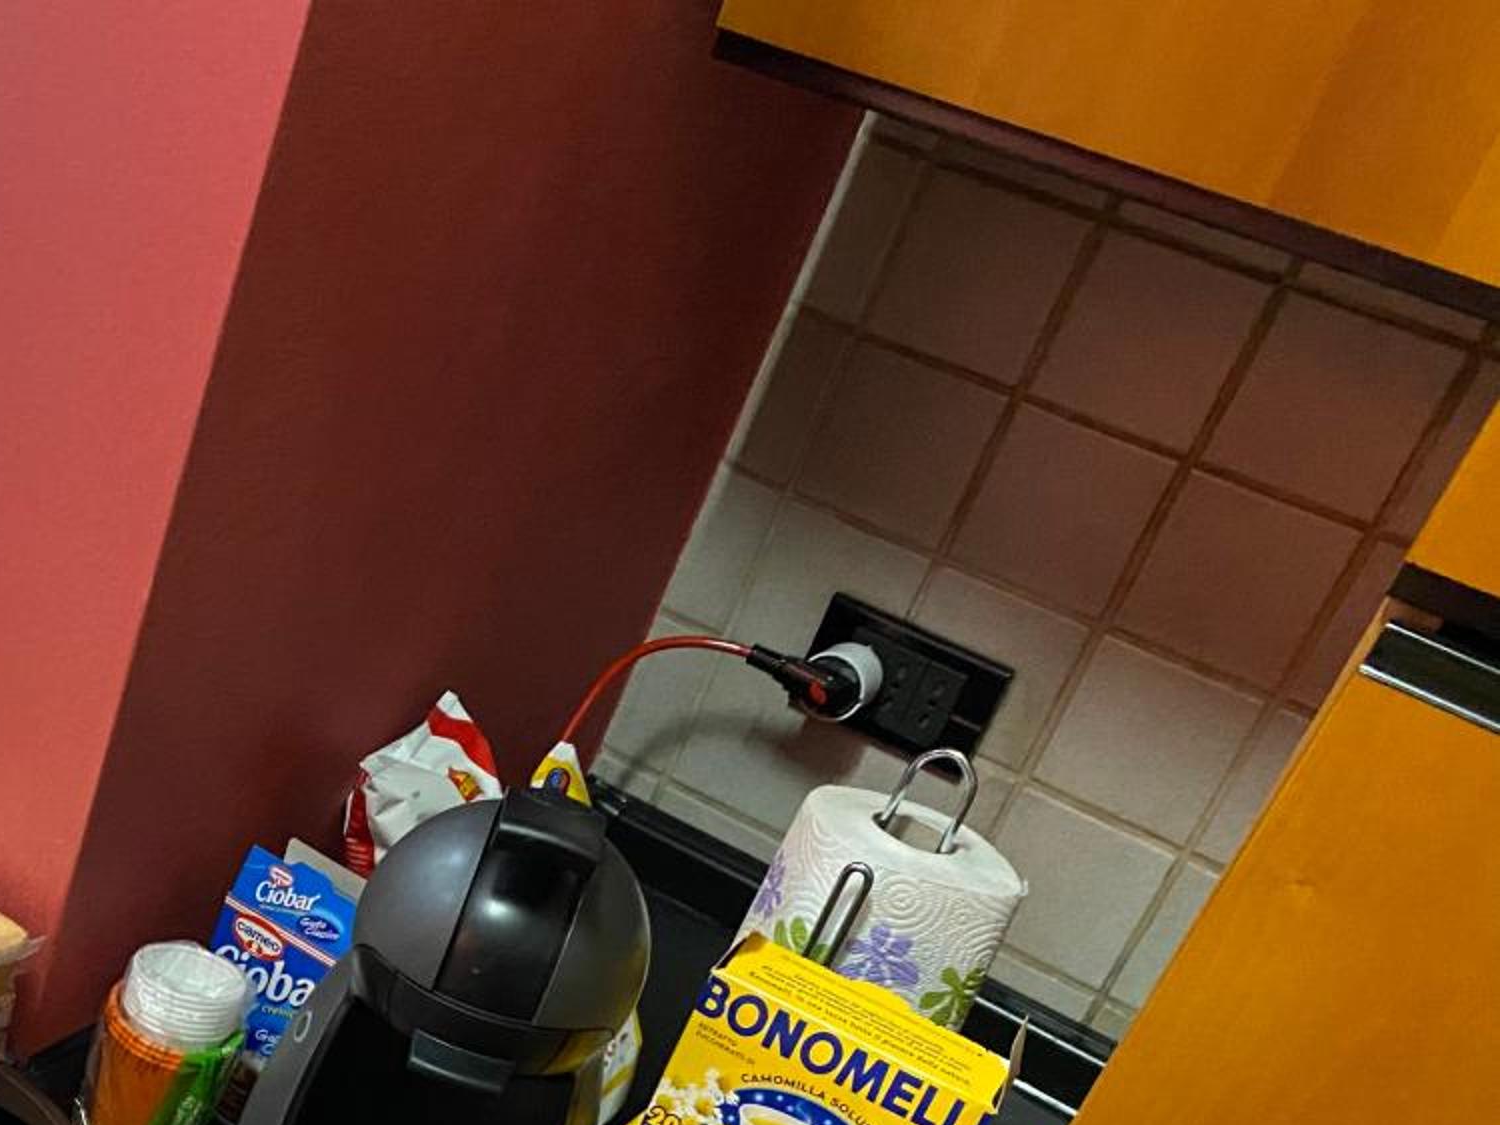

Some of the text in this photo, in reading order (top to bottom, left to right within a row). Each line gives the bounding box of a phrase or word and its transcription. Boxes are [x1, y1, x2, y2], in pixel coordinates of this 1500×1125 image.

[255, 881, 321, 911] Ciobar
[236, 920, 280, 952] cameo
[740, 1073, 826, 1100] CAMOMILLA
